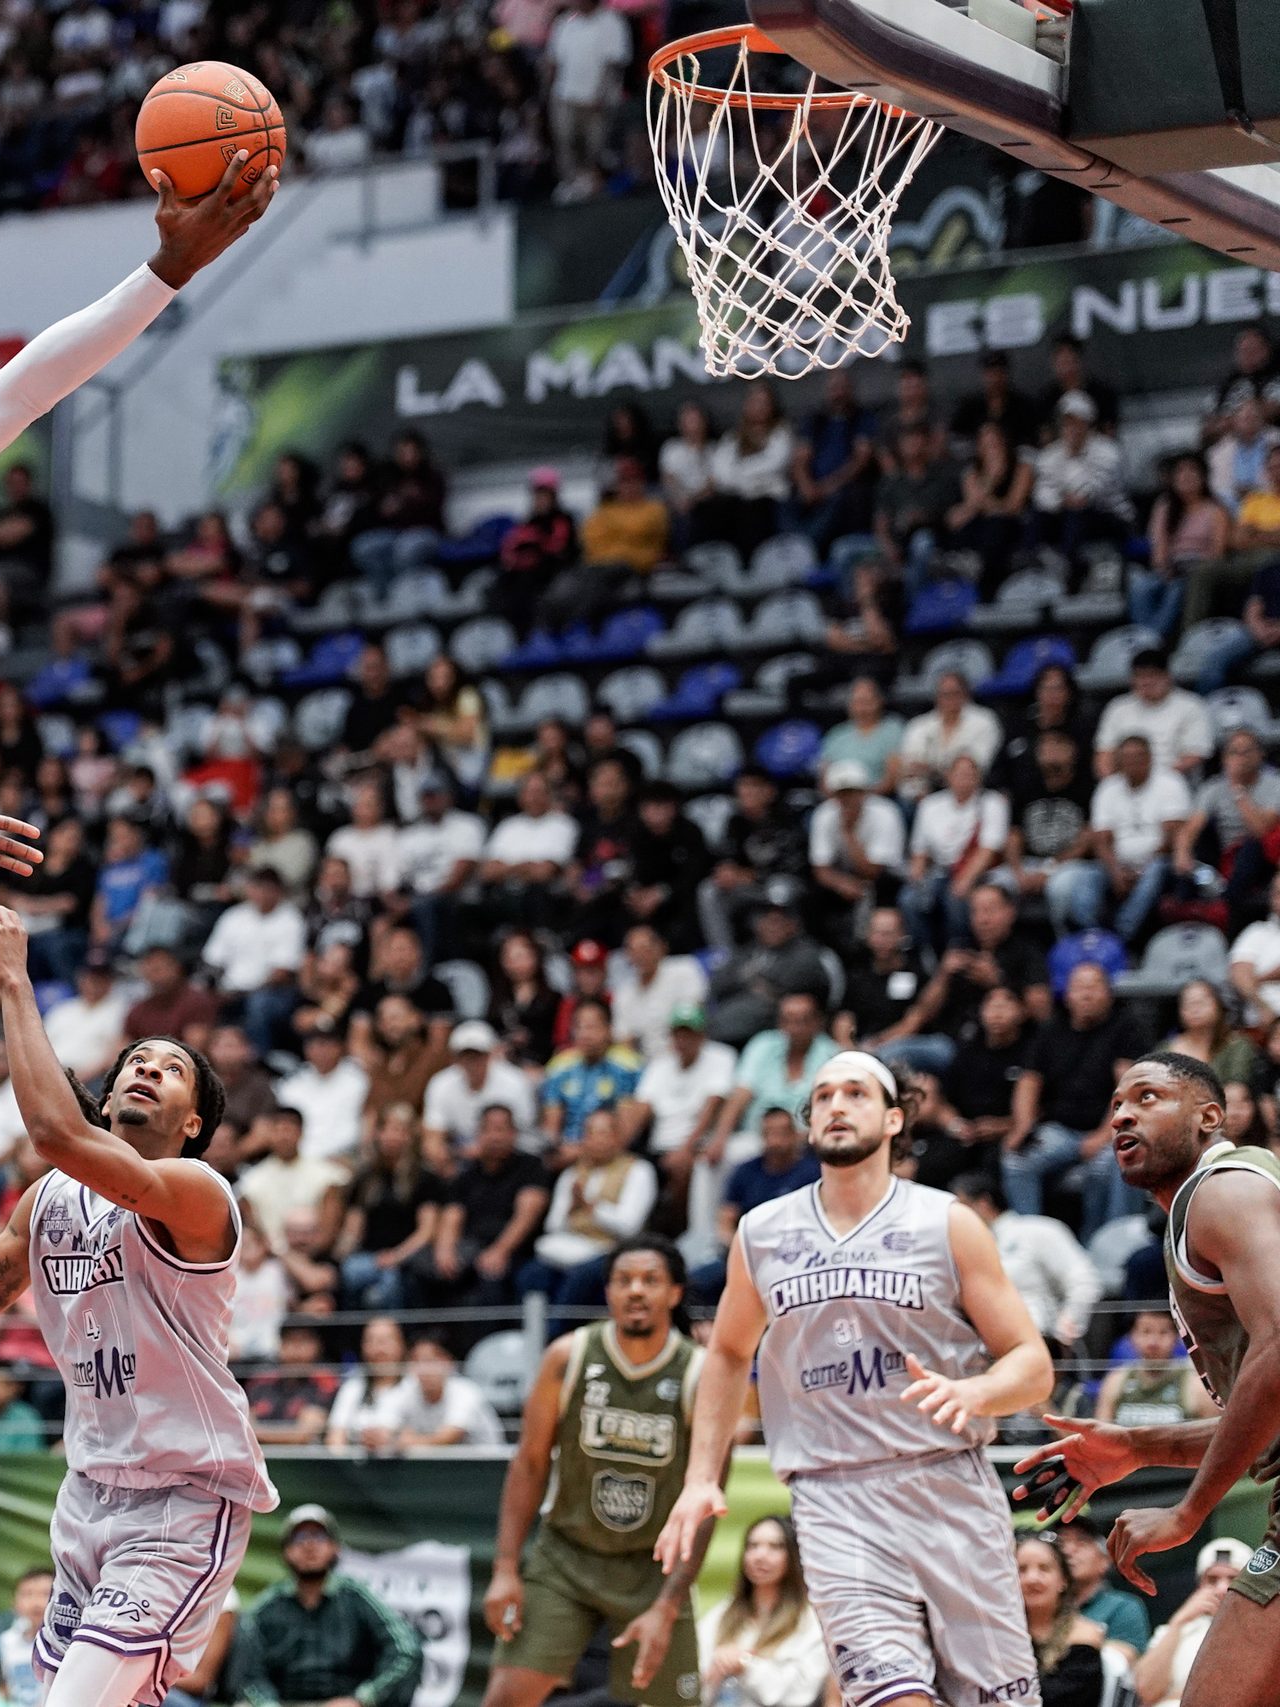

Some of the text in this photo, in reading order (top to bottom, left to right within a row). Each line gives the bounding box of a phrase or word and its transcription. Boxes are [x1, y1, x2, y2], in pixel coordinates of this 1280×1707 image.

[394, 355, 505, 417] LA
[1070, 264, 1280, 342] NUE
[831, 1251, 879, 1265] CIMA
[770, 1267, 924, 1318] CHIHUAHUA
[83, 1309, 101, 1340] 4
[832, 1317, 864, 1347] 31
[801, 1347, 908, 1395] carneMar
